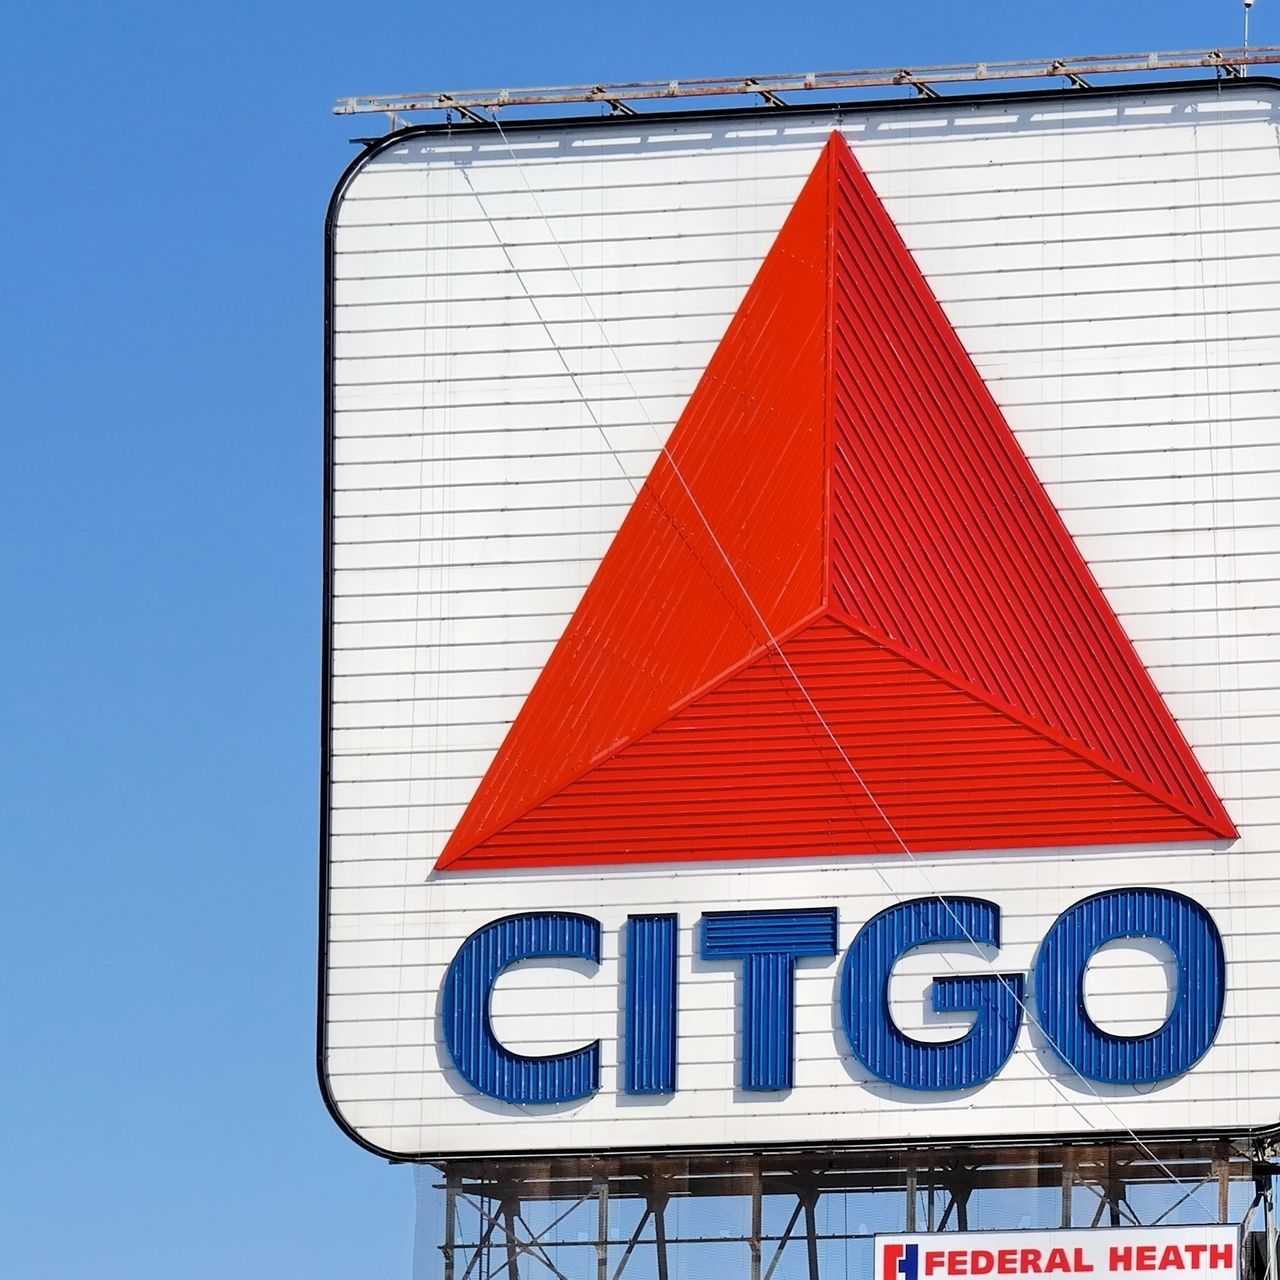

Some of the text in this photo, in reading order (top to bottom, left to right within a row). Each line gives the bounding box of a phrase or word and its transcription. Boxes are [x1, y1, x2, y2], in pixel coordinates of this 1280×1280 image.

[441, 885, 1226, 1105] CITGO
[924, 1247, 1094, 1276] FEDERAL
[1108, 1243, 1233, 1271] HEATH
